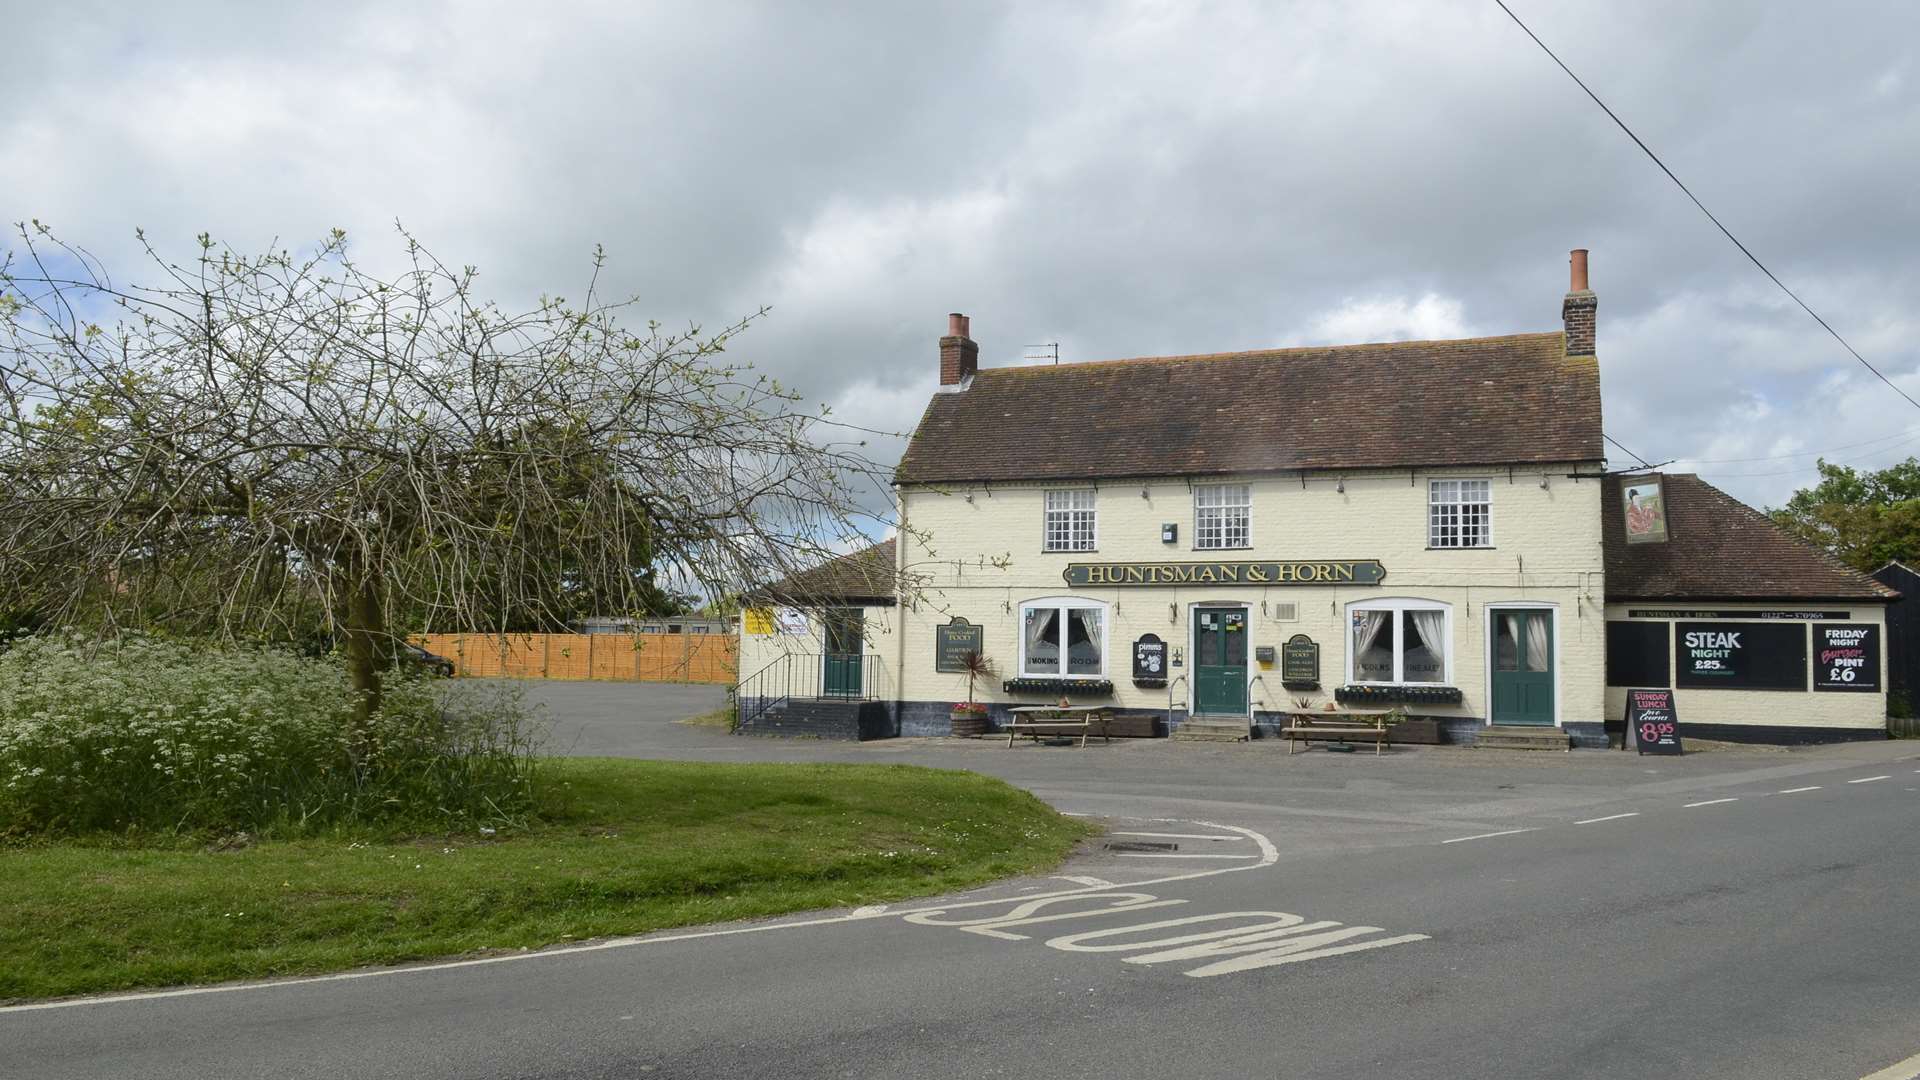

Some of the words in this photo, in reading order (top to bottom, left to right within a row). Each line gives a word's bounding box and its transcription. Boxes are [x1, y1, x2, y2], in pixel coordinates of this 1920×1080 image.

[1087, 564, 1240, 583] HUNTSMAN
[1246, 564, 1270, 582] &
[1278, 562, 1356, 582] HORN
[1825, 629, 1868, 639] FRIDAY
[1685, 632, 1742, 649] STEAK
[1829, 638, 1860, 646] NIGHT
[1691, 649, 1731, 658] NIGHT
[1834, 658, 1865, 667] PINT
[1830, 667, 1856, 682] £6
[1634, 693, 1669, 701] SUNDAY
[1637, 700, 1666, 708] LUNCH
[903, 893, 1432, 978] SLOW
